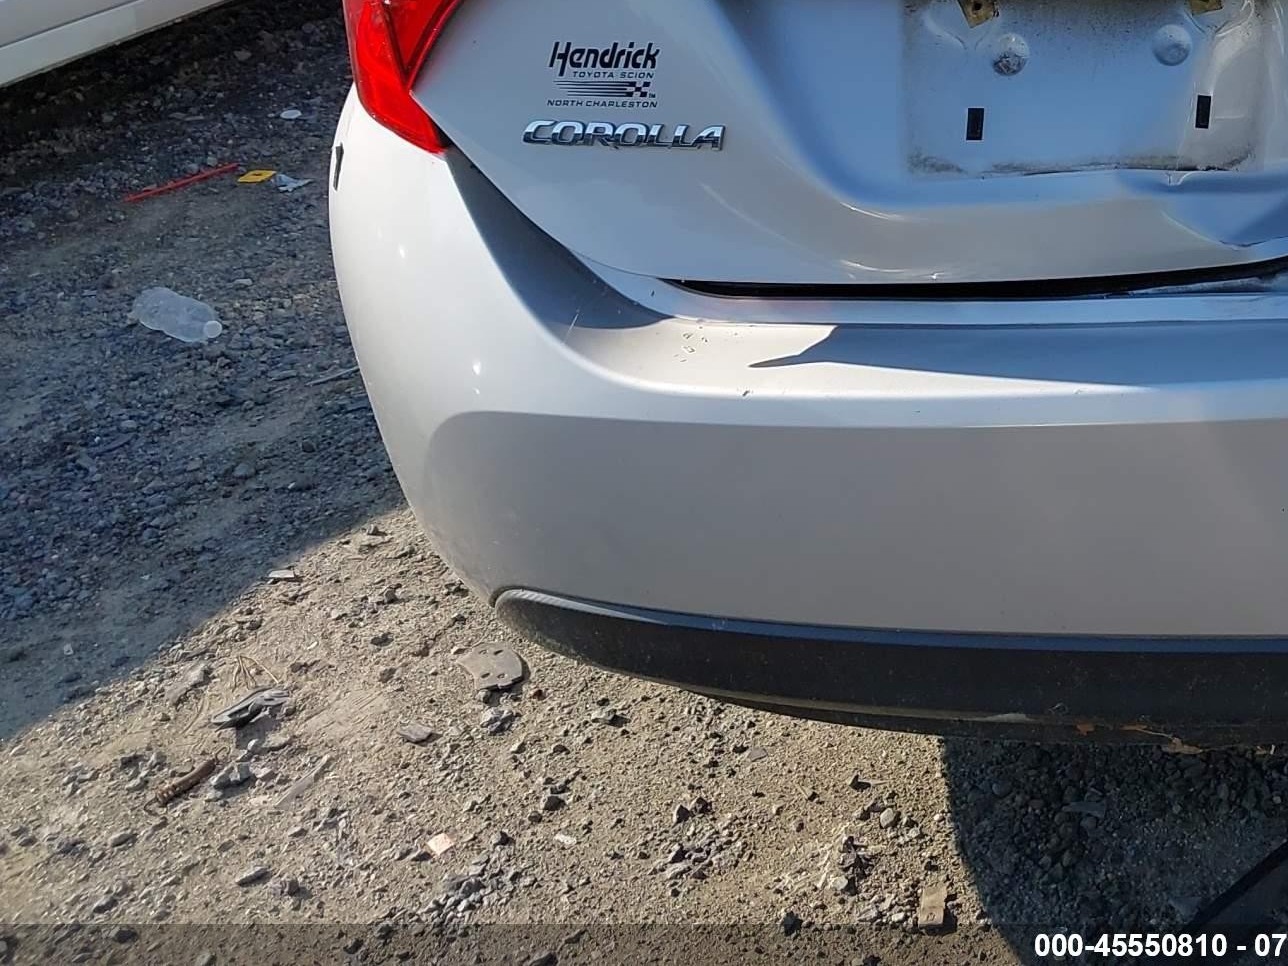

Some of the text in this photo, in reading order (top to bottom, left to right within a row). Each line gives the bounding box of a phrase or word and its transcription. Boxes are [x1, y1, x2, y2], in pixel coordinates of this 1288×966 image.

[549, 41, 660, 77] Hendrick
[572, 71, 655, 79] TOYOTA SCION
[547, 99, 658, 109] NORTH CHARLESTON
[521, 119, 727, 152] COROLLA
